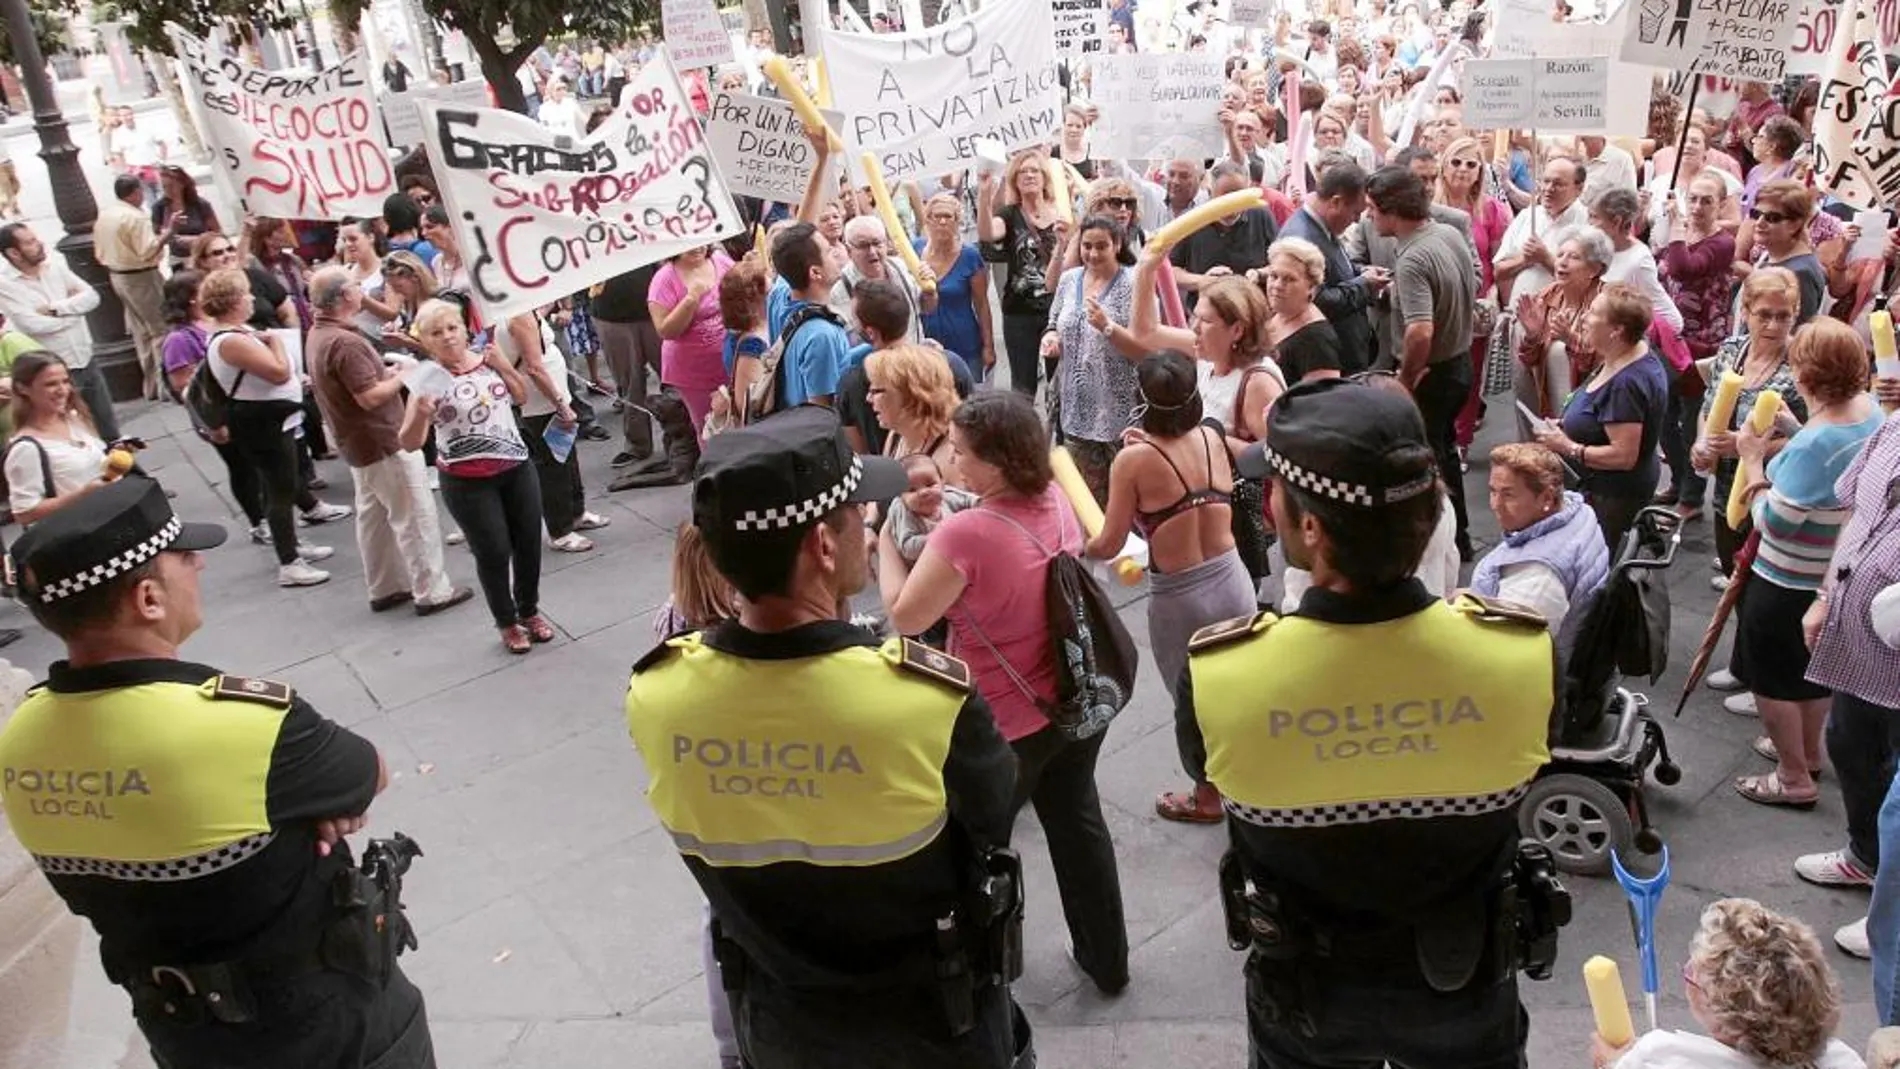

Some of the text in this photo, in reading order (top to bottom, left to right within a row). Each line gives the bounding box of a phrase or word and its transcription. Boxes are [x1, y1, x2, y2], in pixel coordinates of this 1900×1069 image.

[902, 22, 978, 60] NO
[877, 42, 1012, 101] A LA
[711, 93, 751, 124] POR
[755, 105, 783, 132] UN
[1553, 103, 1600, 119] Sevilla
[738, 131, 808, 164] DIGNO
[883, 147, 926, 178] SAN
[246, 138, 393, 217] SALUD
[1268, 695, 1484, 738] POLICIA
[672, 733, 864, 775] POLICIA
[1315, 734, 1440, 762] LOCAL
[4, 767, 151, 796] POLICIA
[709, 774, 823, 799] LOCAL
[30, 798, 114, 820] LOCAL
